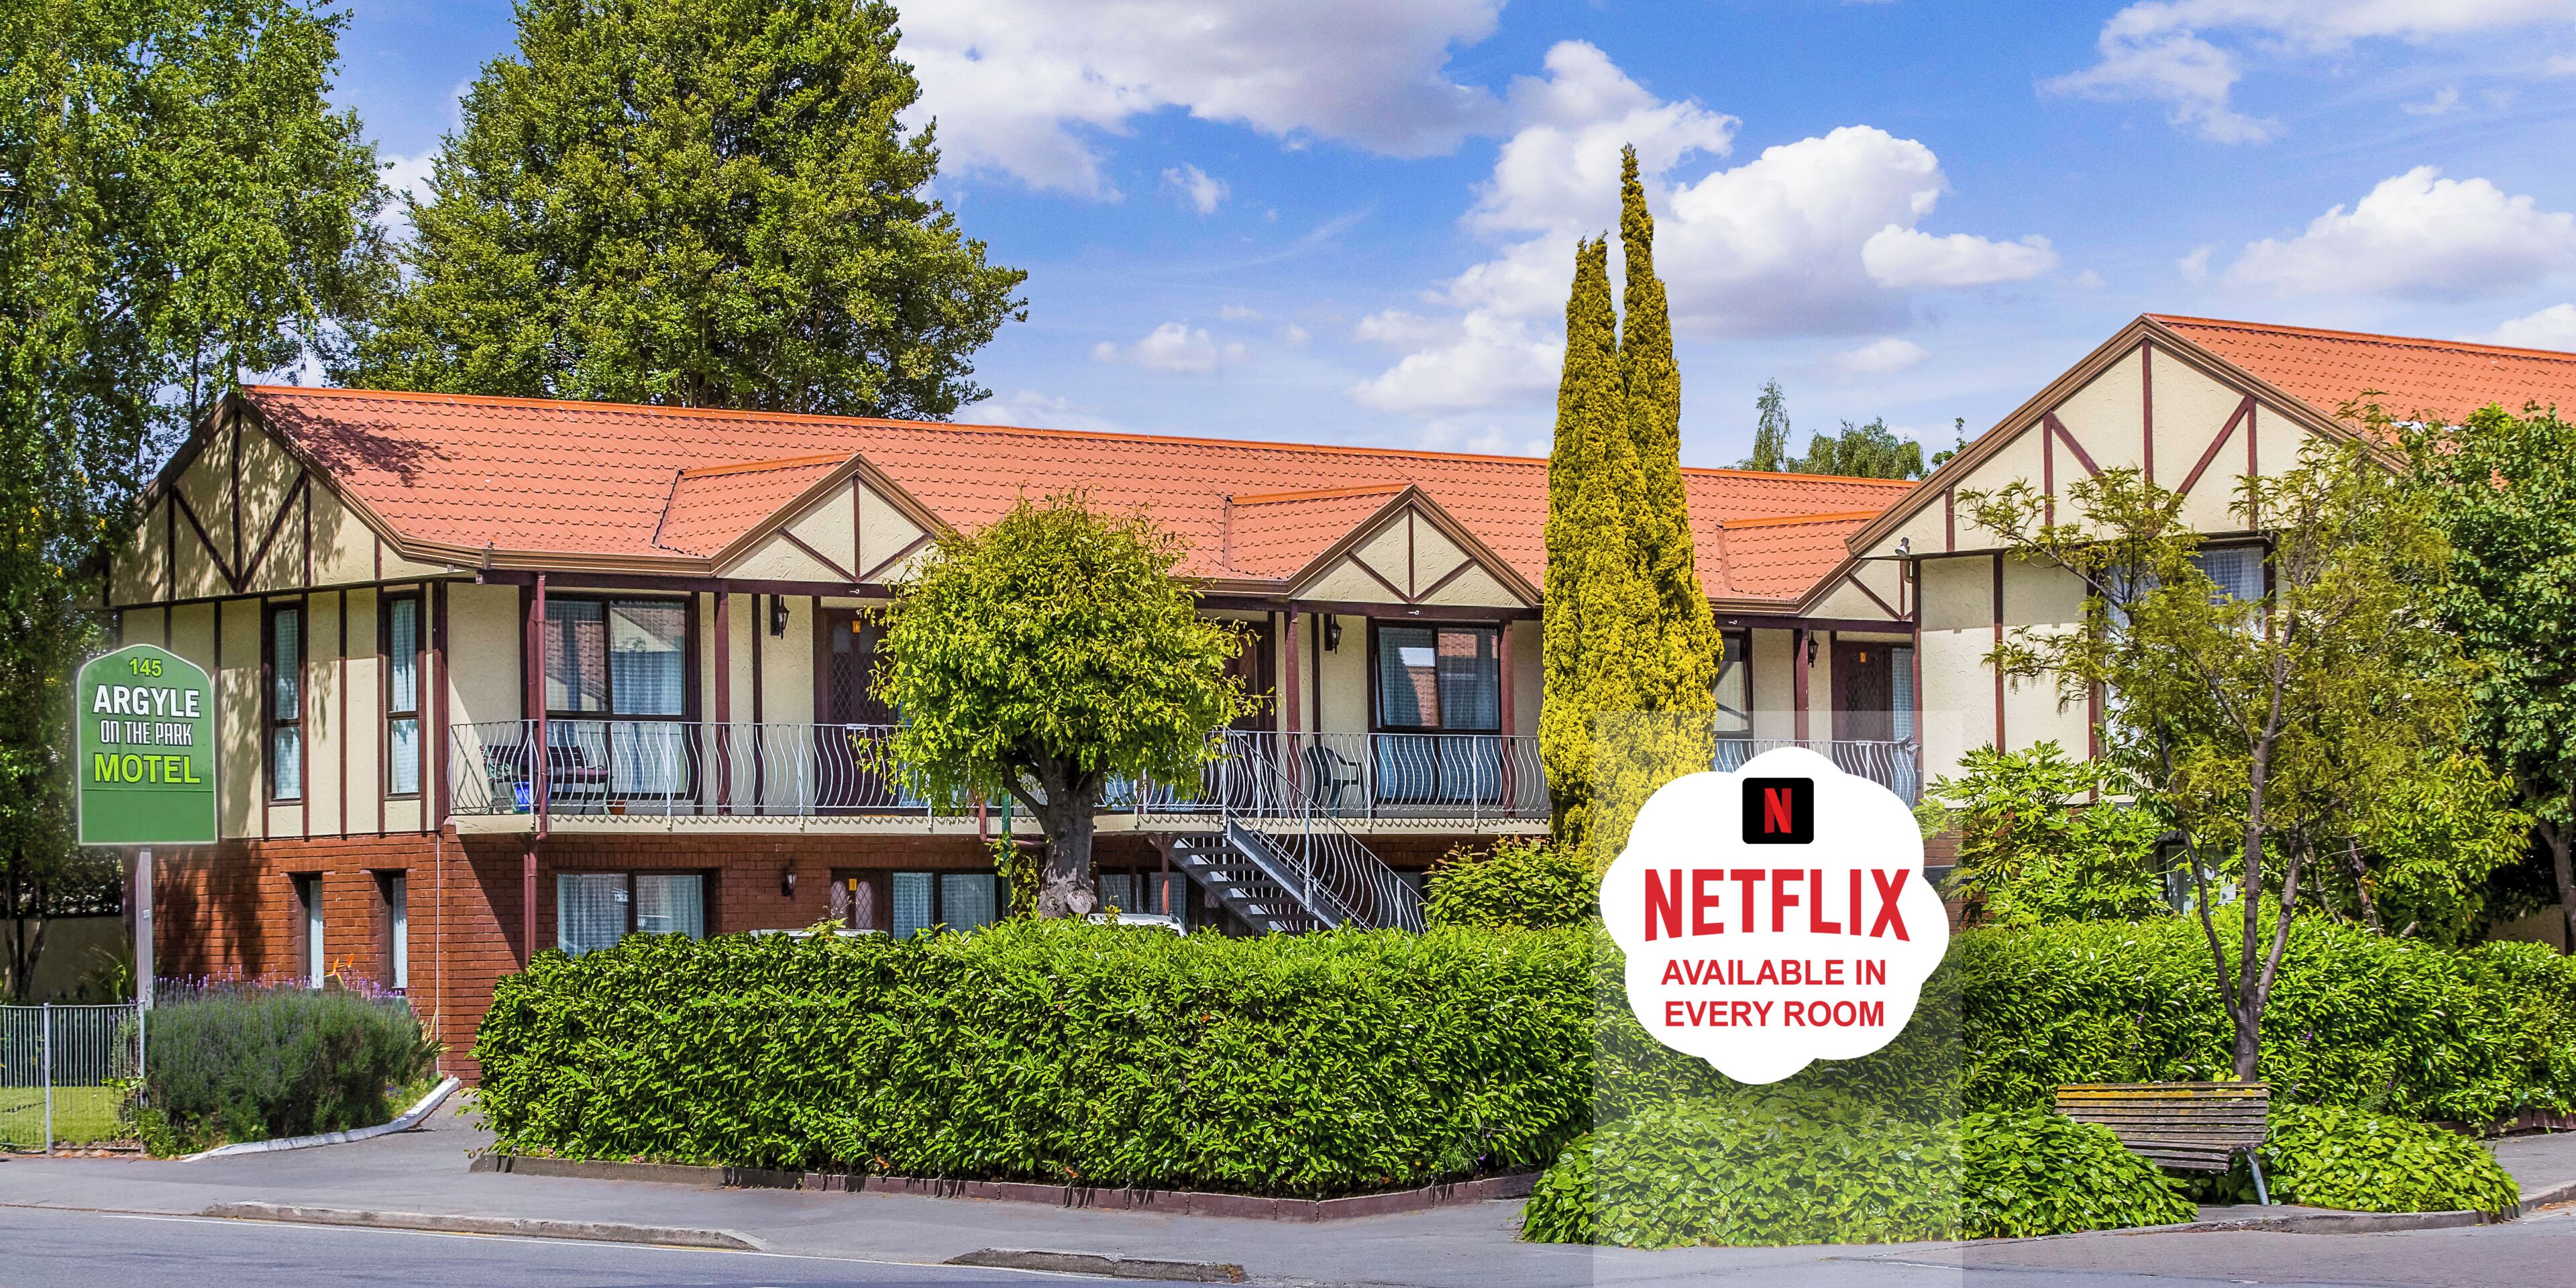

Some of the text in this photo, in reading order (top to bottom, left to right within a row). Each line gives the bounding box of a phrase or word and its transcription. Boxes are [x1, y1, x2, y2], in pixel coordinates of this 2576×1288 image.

[129, 658, 162, 677] 145
[93, 685, 201, 718] ARGYLE
[101, 720, 193, 746] ON THE PARK
[94, 753, 201, 784] MOTEL
